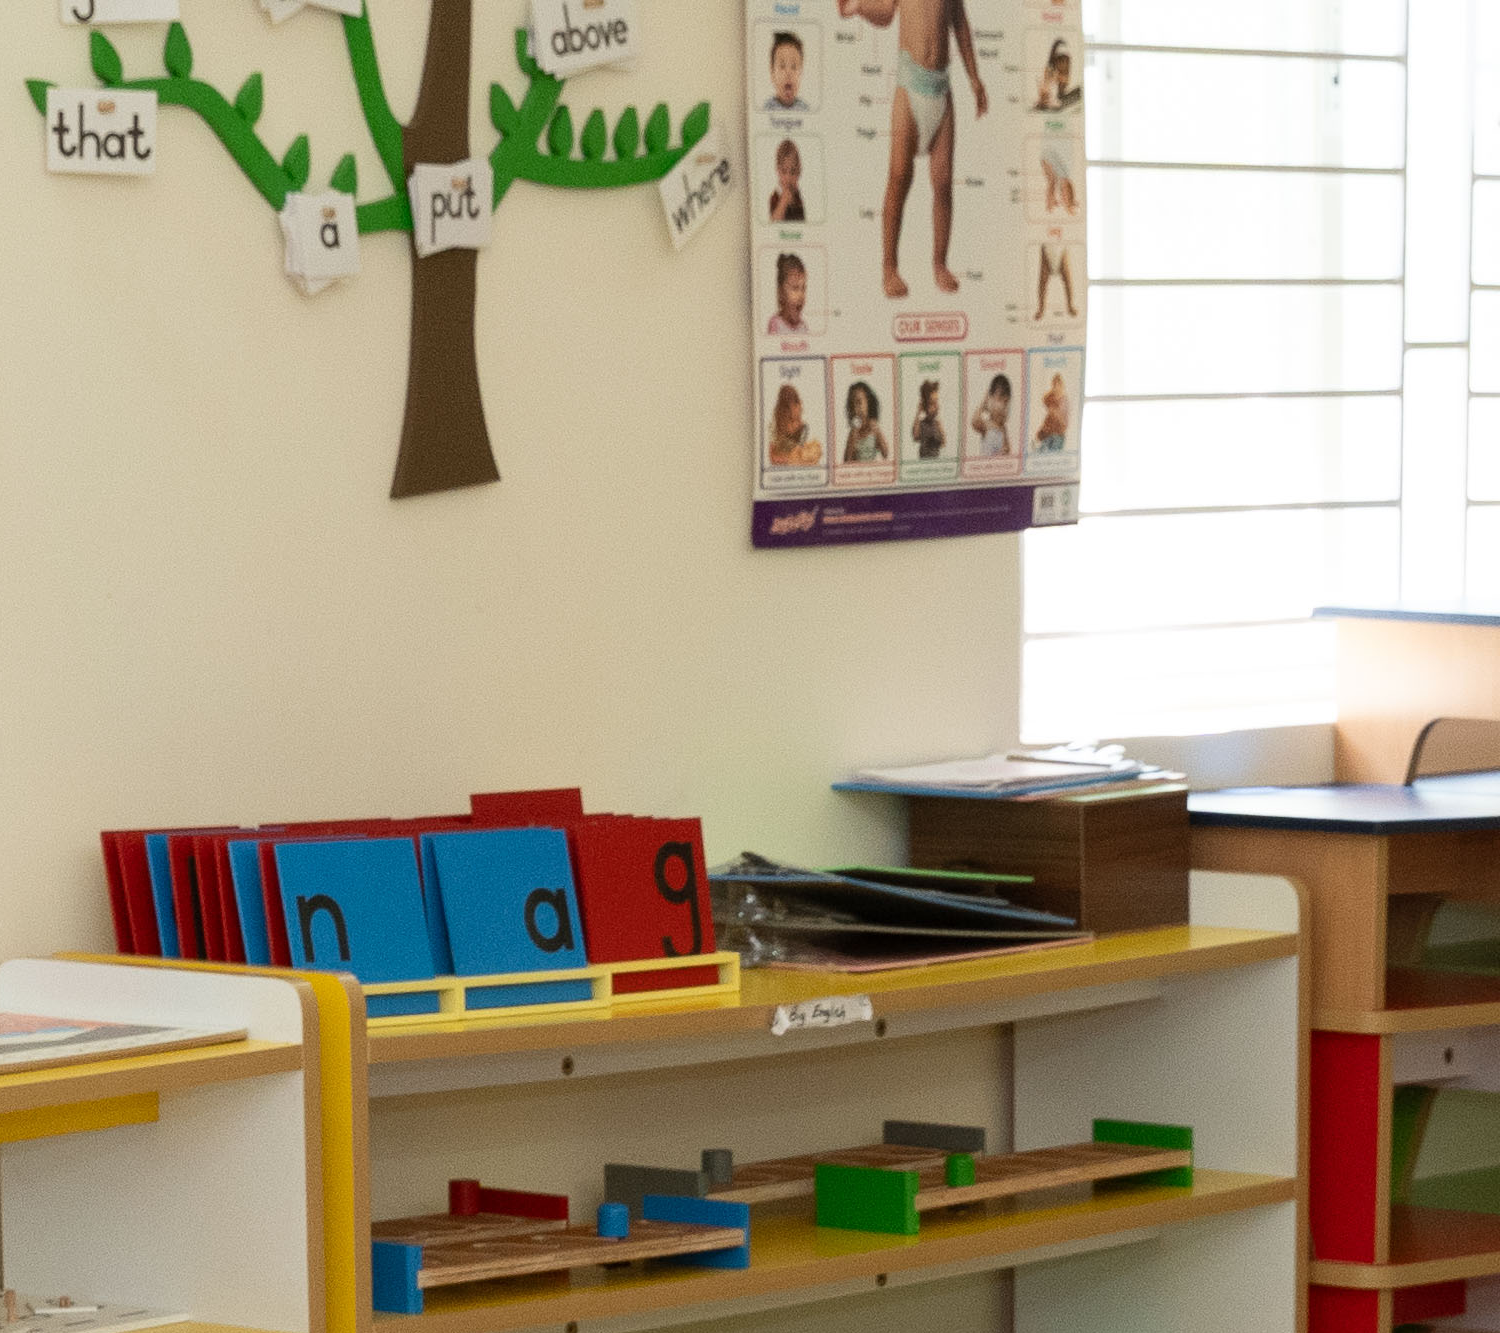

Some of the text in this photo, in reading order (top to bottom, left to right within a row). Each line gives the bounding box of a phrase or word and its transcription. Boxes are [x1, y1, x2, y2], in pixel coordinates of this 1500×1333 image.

[551, 3, 628, 56] above
[52, 104, 151, 160] that
[430, 176, 481, 244] put
[672, 158, 731, 235] where
[320, 222, 341, 249] a
[296, 893, 351, 964] n
[523, 886, 576, 954] a
